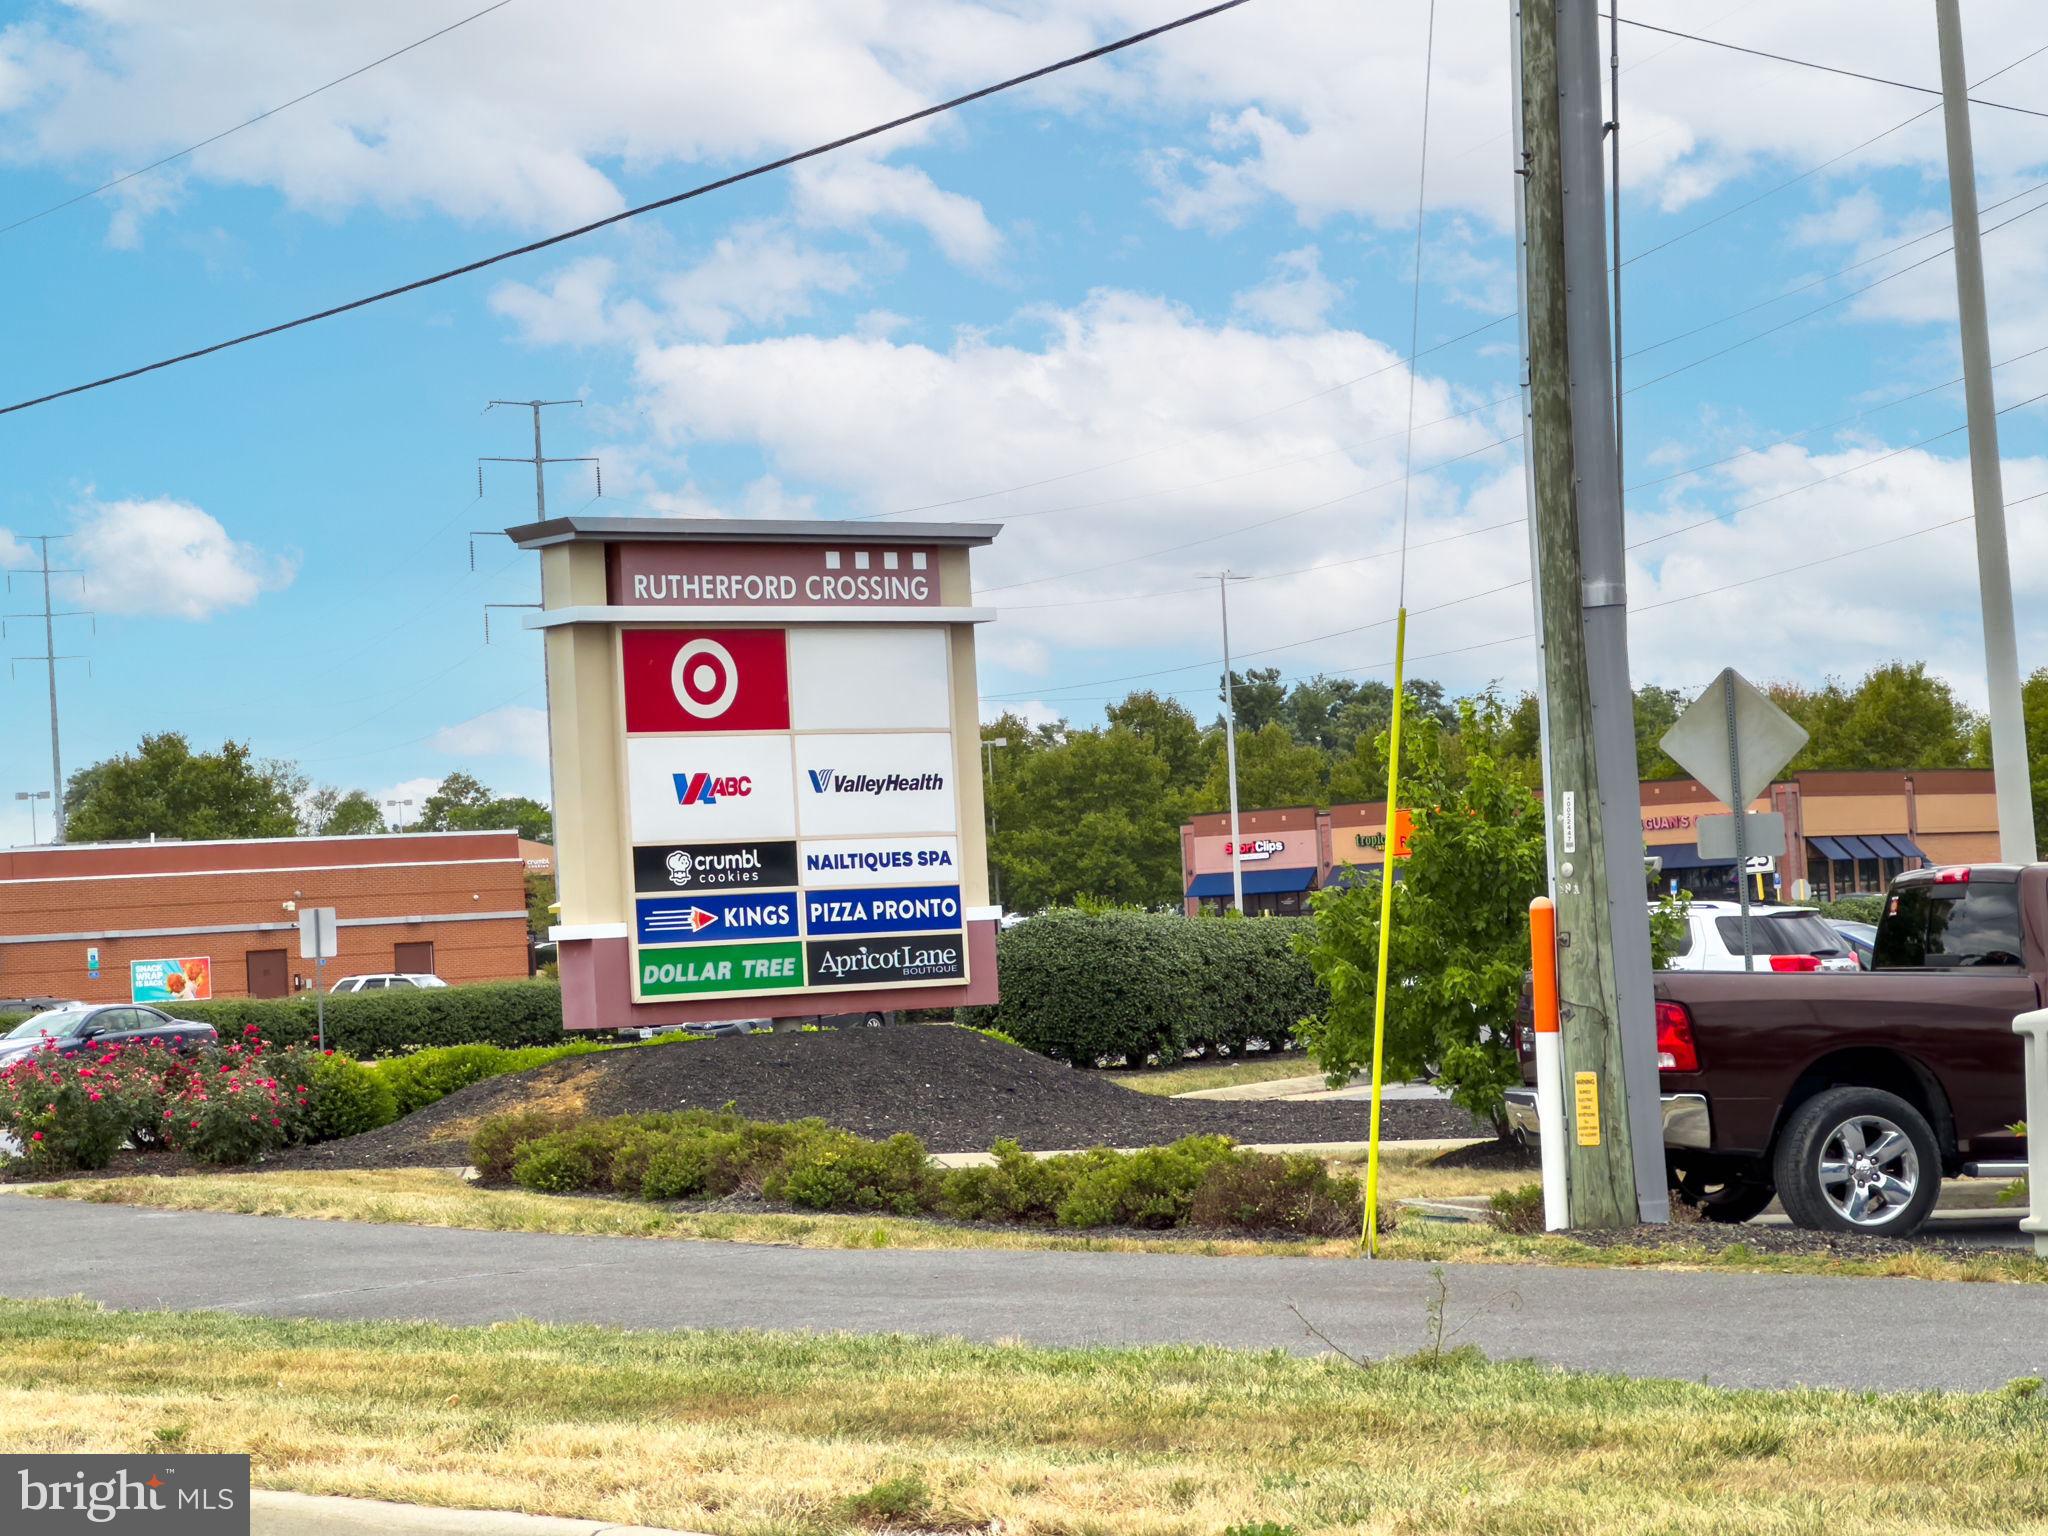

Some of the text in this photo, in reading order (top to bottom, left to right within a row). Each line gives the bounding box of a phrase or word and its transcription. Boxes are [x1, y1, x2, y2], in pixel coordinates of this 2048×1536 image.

[633, 574, 929, 600] RUTHERFORD CROSSING
[708, 776, 753, 797] ABC
[1224, 840, 1285, 855] SortClips
[1356, 833, 1386, 846] tropic
[694, 849, 762, 871] crumbl
[806, 850, 953, 871] NAILTIQUES SPA
[699, 871, 759, 883] cookies
[724, 905, 790, 928] KINGS
[811, 898, 957, 923] PIZZA PRONTO
[643, 957, 796, 984] DOLLAR TREE
[902, 964, 957, 975] BOUTIQUE
